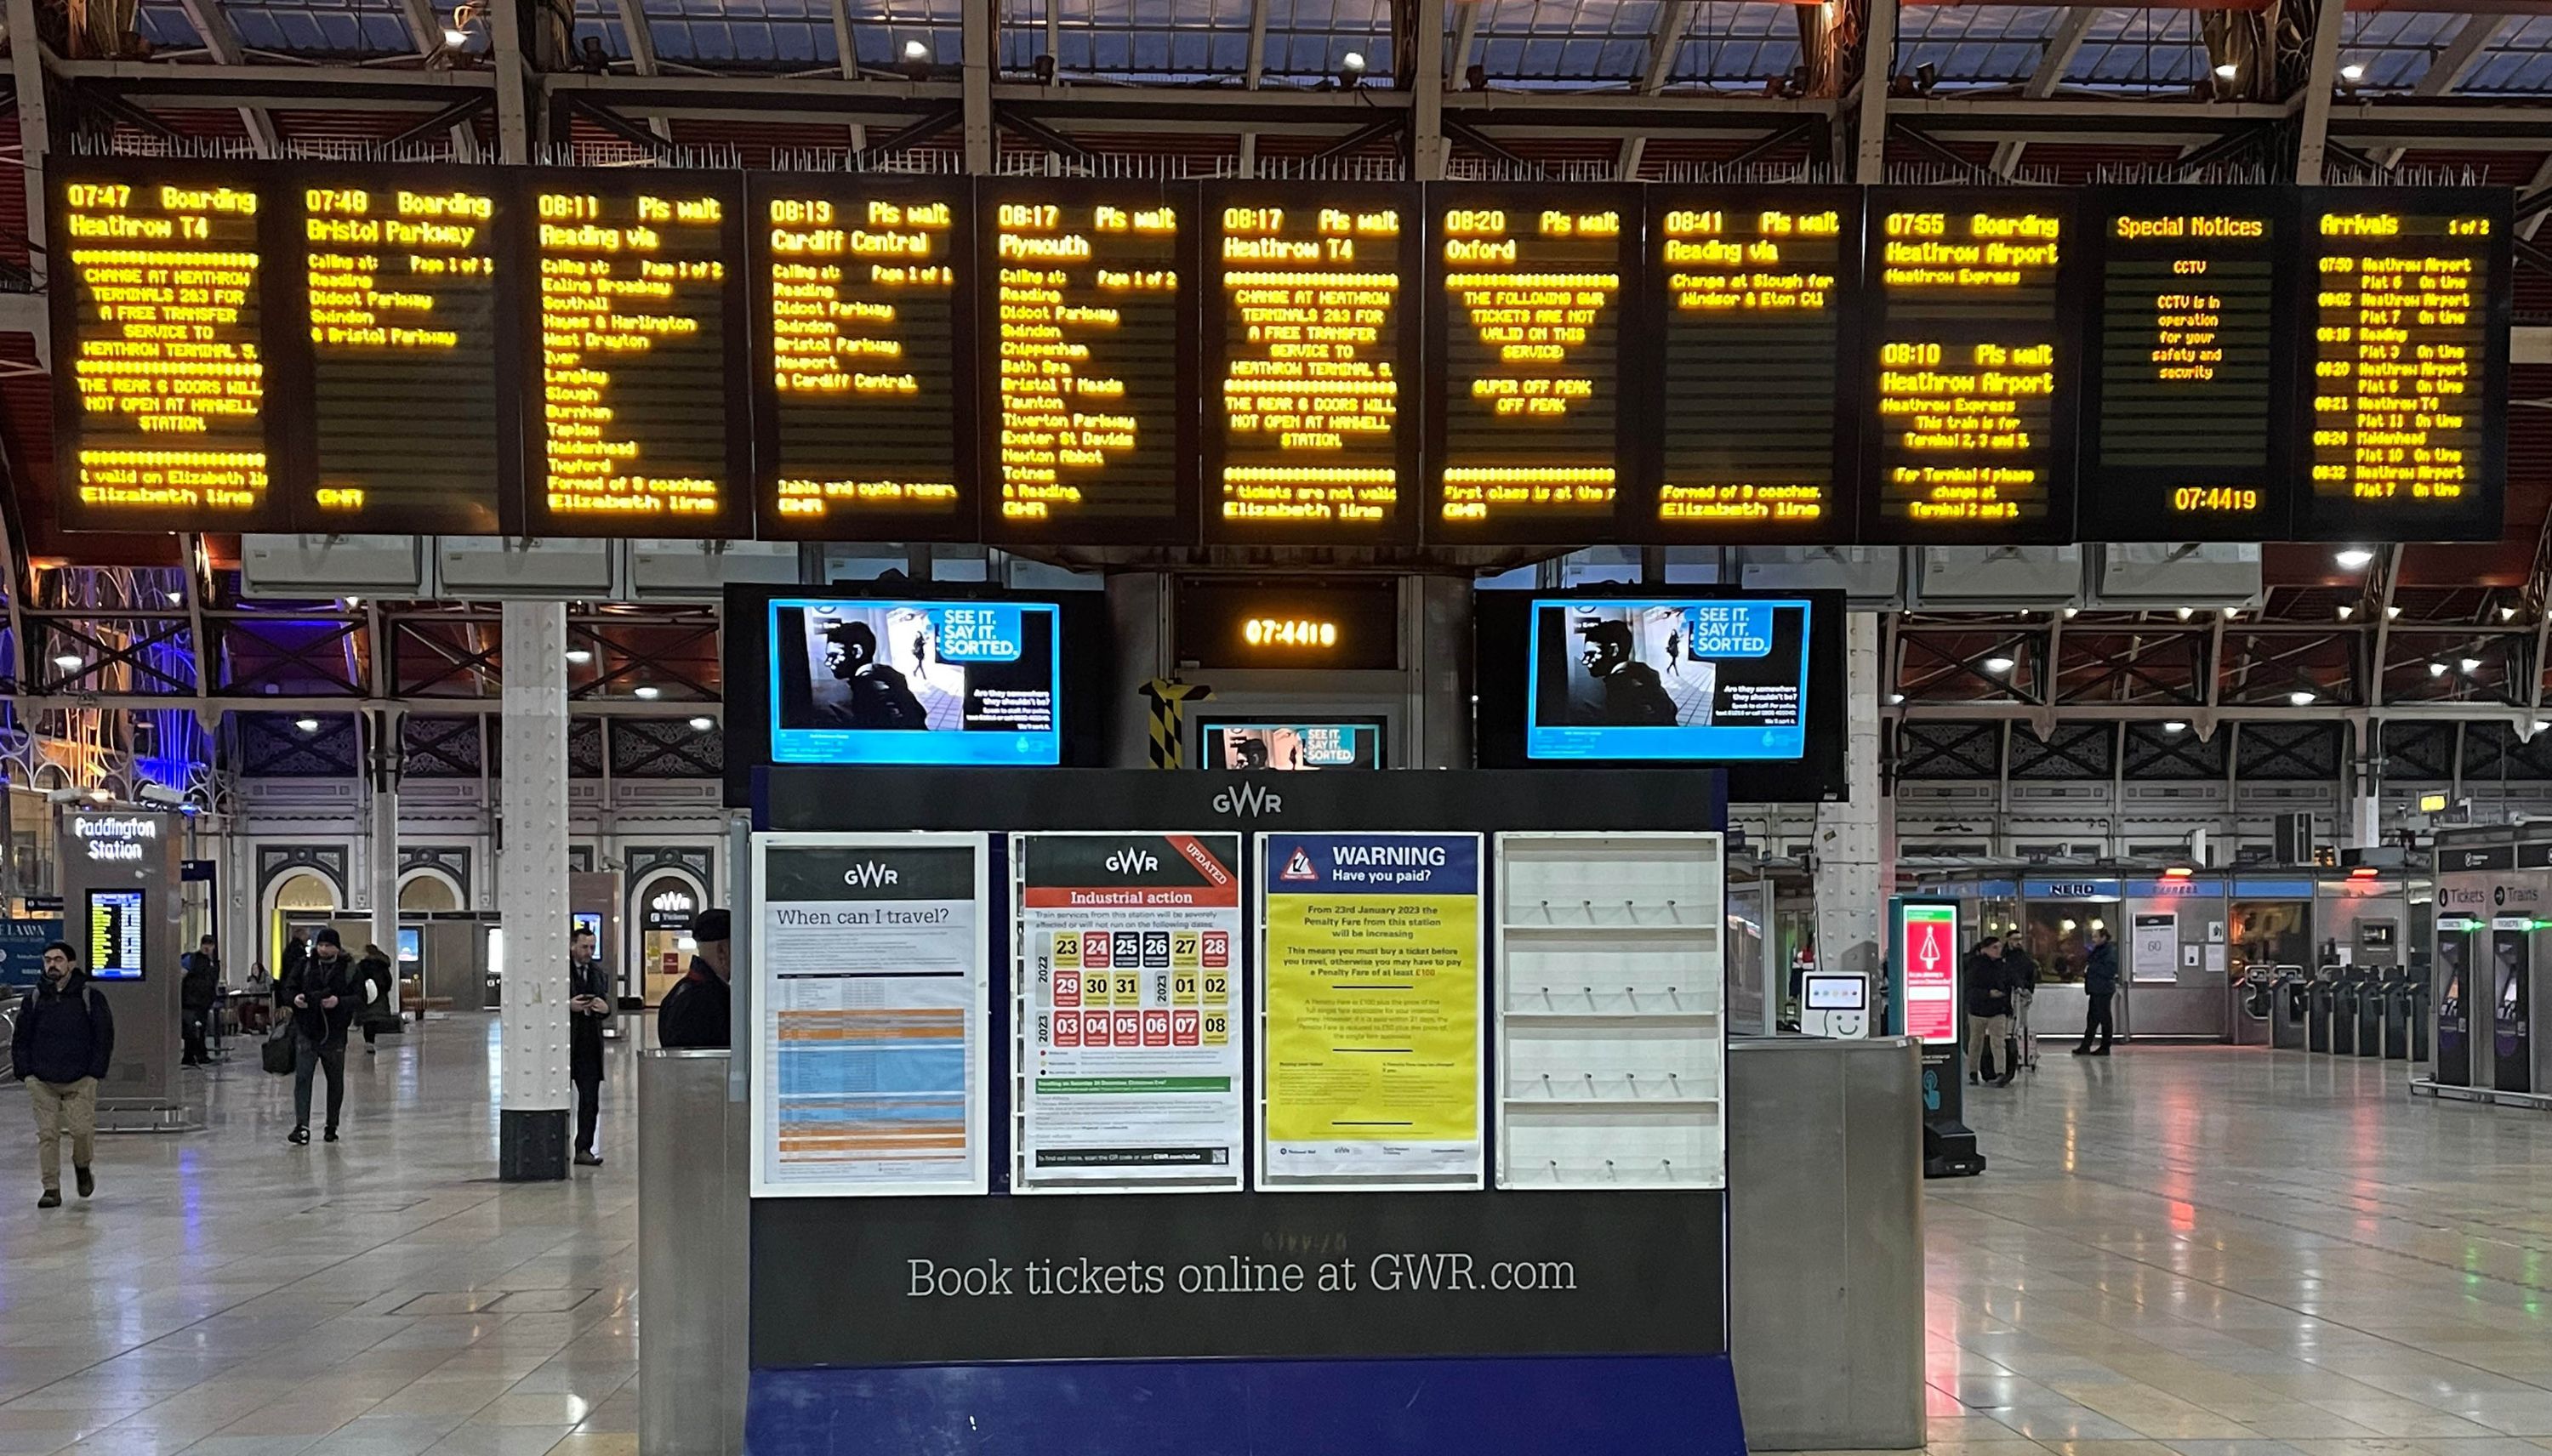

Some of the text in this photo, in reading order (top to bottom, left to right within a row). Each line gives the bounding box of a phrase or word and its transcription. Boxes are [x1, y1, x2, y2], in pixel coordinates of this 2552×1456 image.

[68, 185, 256, 215] 07:47 Boarding
[306, 190, 492, 219] 07:48 Boarding
[539, 195, 721, 222] 08:11 Pls wait
[771, 200, 950, 226] 08:13 Pls wait
[1000, 205, 1176, 231] 08:17 Pls wait
[1224, 208, 1398, 234] 08:17 Pls wait
[1446, 211, 1620, 235] 08:20 Pls wait
[1666, 211, 1839, 234] 08:41 Pls wait
[2321, 213, 2399, 235] Arrivals
[70, 214, 208, 239] Heathrow T4
[307, 219, 475, 247] Bristol Parkway
[1887, 213, 2059, 238] 07:55 Boarding
[2117, 216, 2262, 239] Special Notices
[540, 225, 659, 252] Reading via
[772, 229, 929, 255] Cardiff Central
[999, 234, 1091, 259] Plymouth
[1223, 237, 1353, 260] Heathrow T4
[1445, 240, 1516, 262] Oxford
[1665, 240, 1778, 265] Reading via
[1885, 242, 2059, 266] Heathrow Airport
[2174, 260, 2206, 274] CCTV
[2157, 295, 2220, 309] CCTV is in
[2158, 313, 2219, 327] operation
[2160, 331, 2214, 344] for your
[1882, 344, 2054, 366] 08:10 Pls wait
[2152, 348, 2222, 362] safety and
[2160, 365, 2213, 379] security
[1881, 372, 2054, 395] Heathrow Airport
[943, 609, 997, 625] SEE IT.
[1699, 606, 1750, 622] SEE IT.
[943, 624, 997, 640] SAY IT.
[1699, 622, 1749, 636] SAY IT.
[943, 639, 1019, 656] SORTED.
[1698, 636, 1769, 652] SORTED.
[1307, 730, 1341, 740] SEE IT.
[1307, 740, 1341, 750] SAY IT.
[1307, 750, 1354, 761] SORTED.
[1213, 782, 1281, 817] GWR
[75, 817, 155, 839] Paddington
[88, 840, 142, 860] Station
[1106, 847, 1158, 874] GWR
[1333, 847, 1444, 866] WARNING
[845, 861, 897, 888] GWR
[1186, 843, 1227, 884] UPDATED
[1333, 869, 1431, 884] Have you paid?
[1071, 891, 1193, 903] Industrial action
[2450, 888, 2485, 903] Tickets
[2507, 887, 2538, 901] Trains
[777, 908, 948, 924] When can I travel?
[1358, 906, 1395, 915] January
[1305, 917, 1339, 927] Penalty
[1366, 930, 1413, 939] increasing
[1056, 940, 1226, 955] 23 24 25 26 27 28
[1381, 947, 1396, 956] buy
[1038, 956, 1048, 983] 2022
[1056, 979, 1136, 993] 29 30 31
[1157, 975, 1167, 1002] 2023
[1176, 979, 1226, 993] 01 02
[1039, 1015, 1048, 1043] 2023
[1056, 1018, 1226, 1034] 03 04 05 06 07 08
[908, 1254, 1577, 1295] Book tickets online at GWR.com
